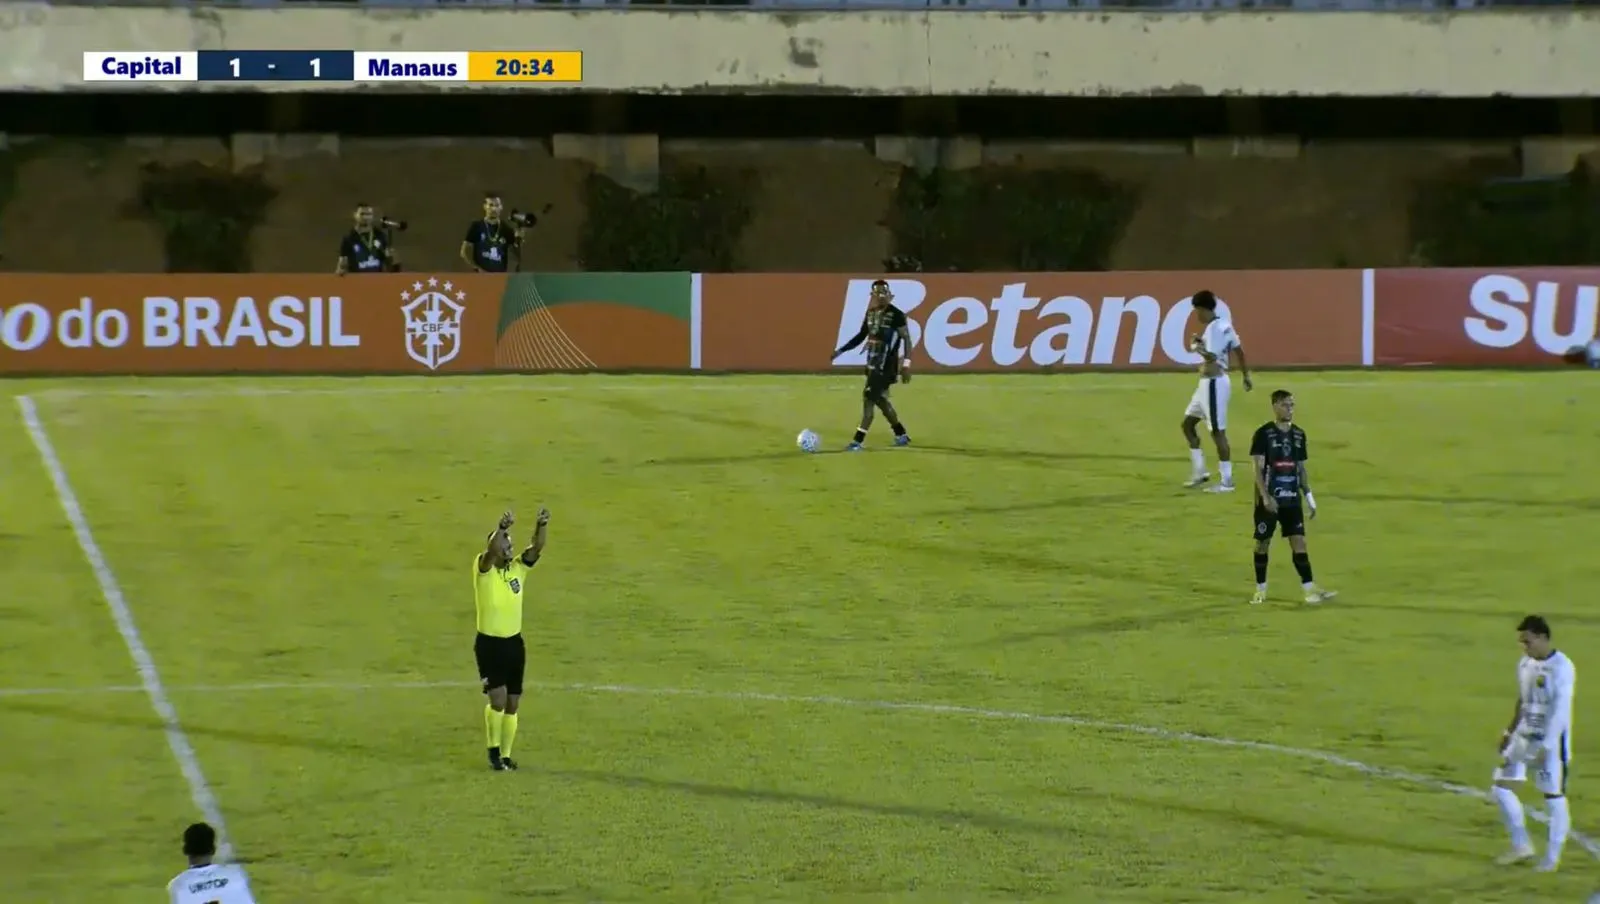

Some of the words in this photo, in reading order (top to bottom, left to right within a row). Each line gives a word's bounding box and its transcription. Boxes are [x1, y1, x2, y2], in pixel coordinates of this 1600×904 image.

[0, 303, 52, 351] o
[58, 297, 129, 348] do
[143, 295, 361, 348] BRASIL
[421, 323, 444, 333] CBF
[831, 279, 1233, 367] Betano
